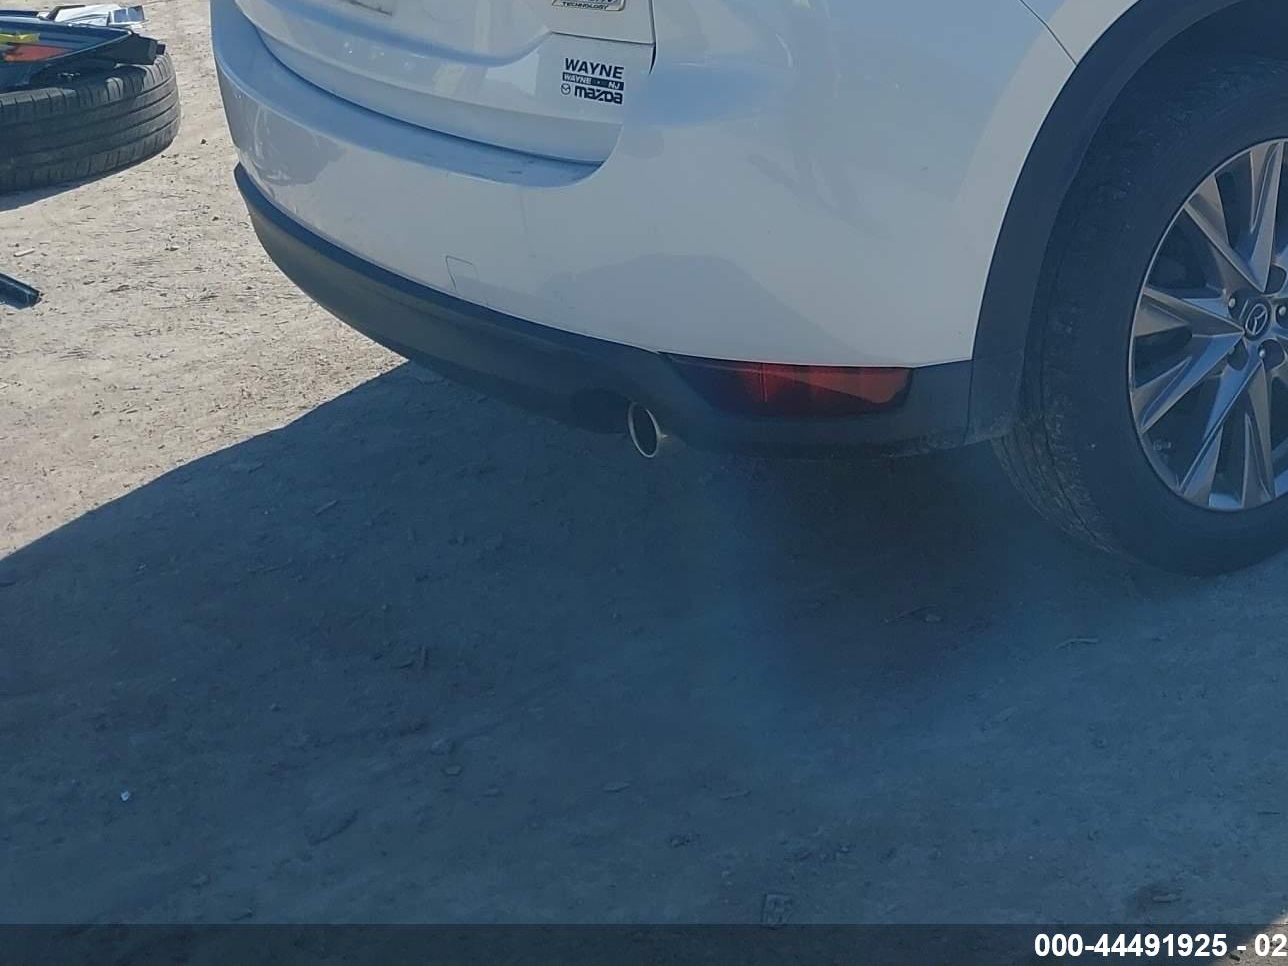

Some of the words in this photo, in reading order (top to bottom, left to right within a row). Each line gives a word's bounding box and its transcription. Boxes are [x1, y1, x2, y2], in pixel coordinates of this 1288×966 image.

[561, 1, 609, 10] TECHNOLOGY
[565, 57, 624, 79] WAYNE
[564, 74, 592, 85] WAYNE
[608, 82, 621, 90] NJ
[574, 85, 623, 105] mazda
